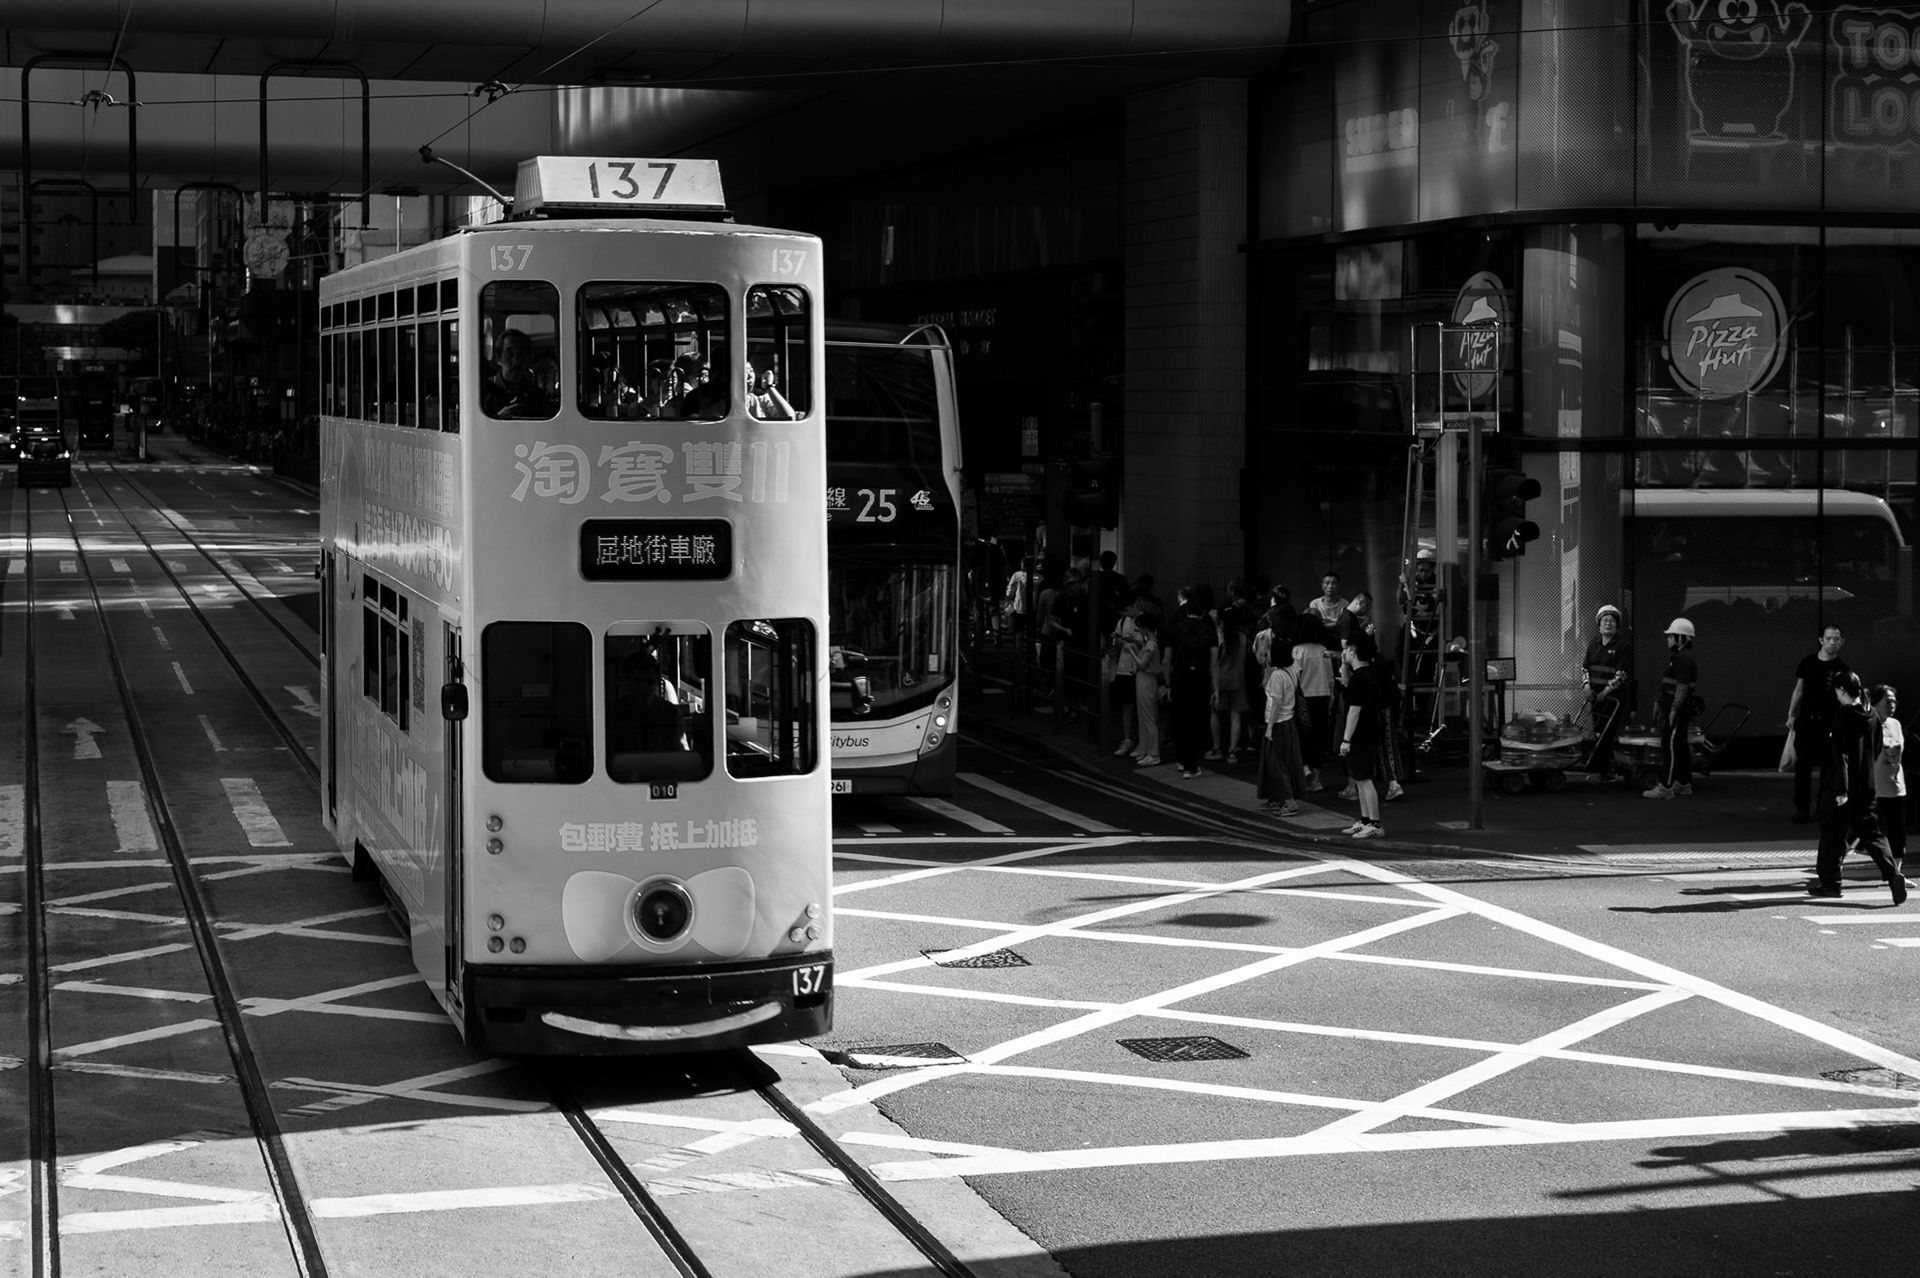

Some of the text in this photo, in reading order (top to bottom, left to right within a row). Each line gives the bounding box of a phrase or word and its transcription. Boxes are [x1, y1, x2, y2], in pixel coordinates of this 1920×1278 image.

[1843, 19, 1920, 70] TO
[1843, 86, 1920, 136] LO
[588, 162, 676, 199] 137
[490, 244, 534, 272] 137
[772, 248, 808, 276] 137
[1686, 320, 1758, 358] Pizza
[1698, 343, 1755, 377] Hut
[856, 488, 897, 523] 25
[596, 534, 716, 566] 屈地街車廠
[830, 735, 870, 749] itybus
[652, 784, 675, 797] 010
[559, 817, 759, 852] 包郵費 抵上加抵
[792, 965, 826, 997] 137
